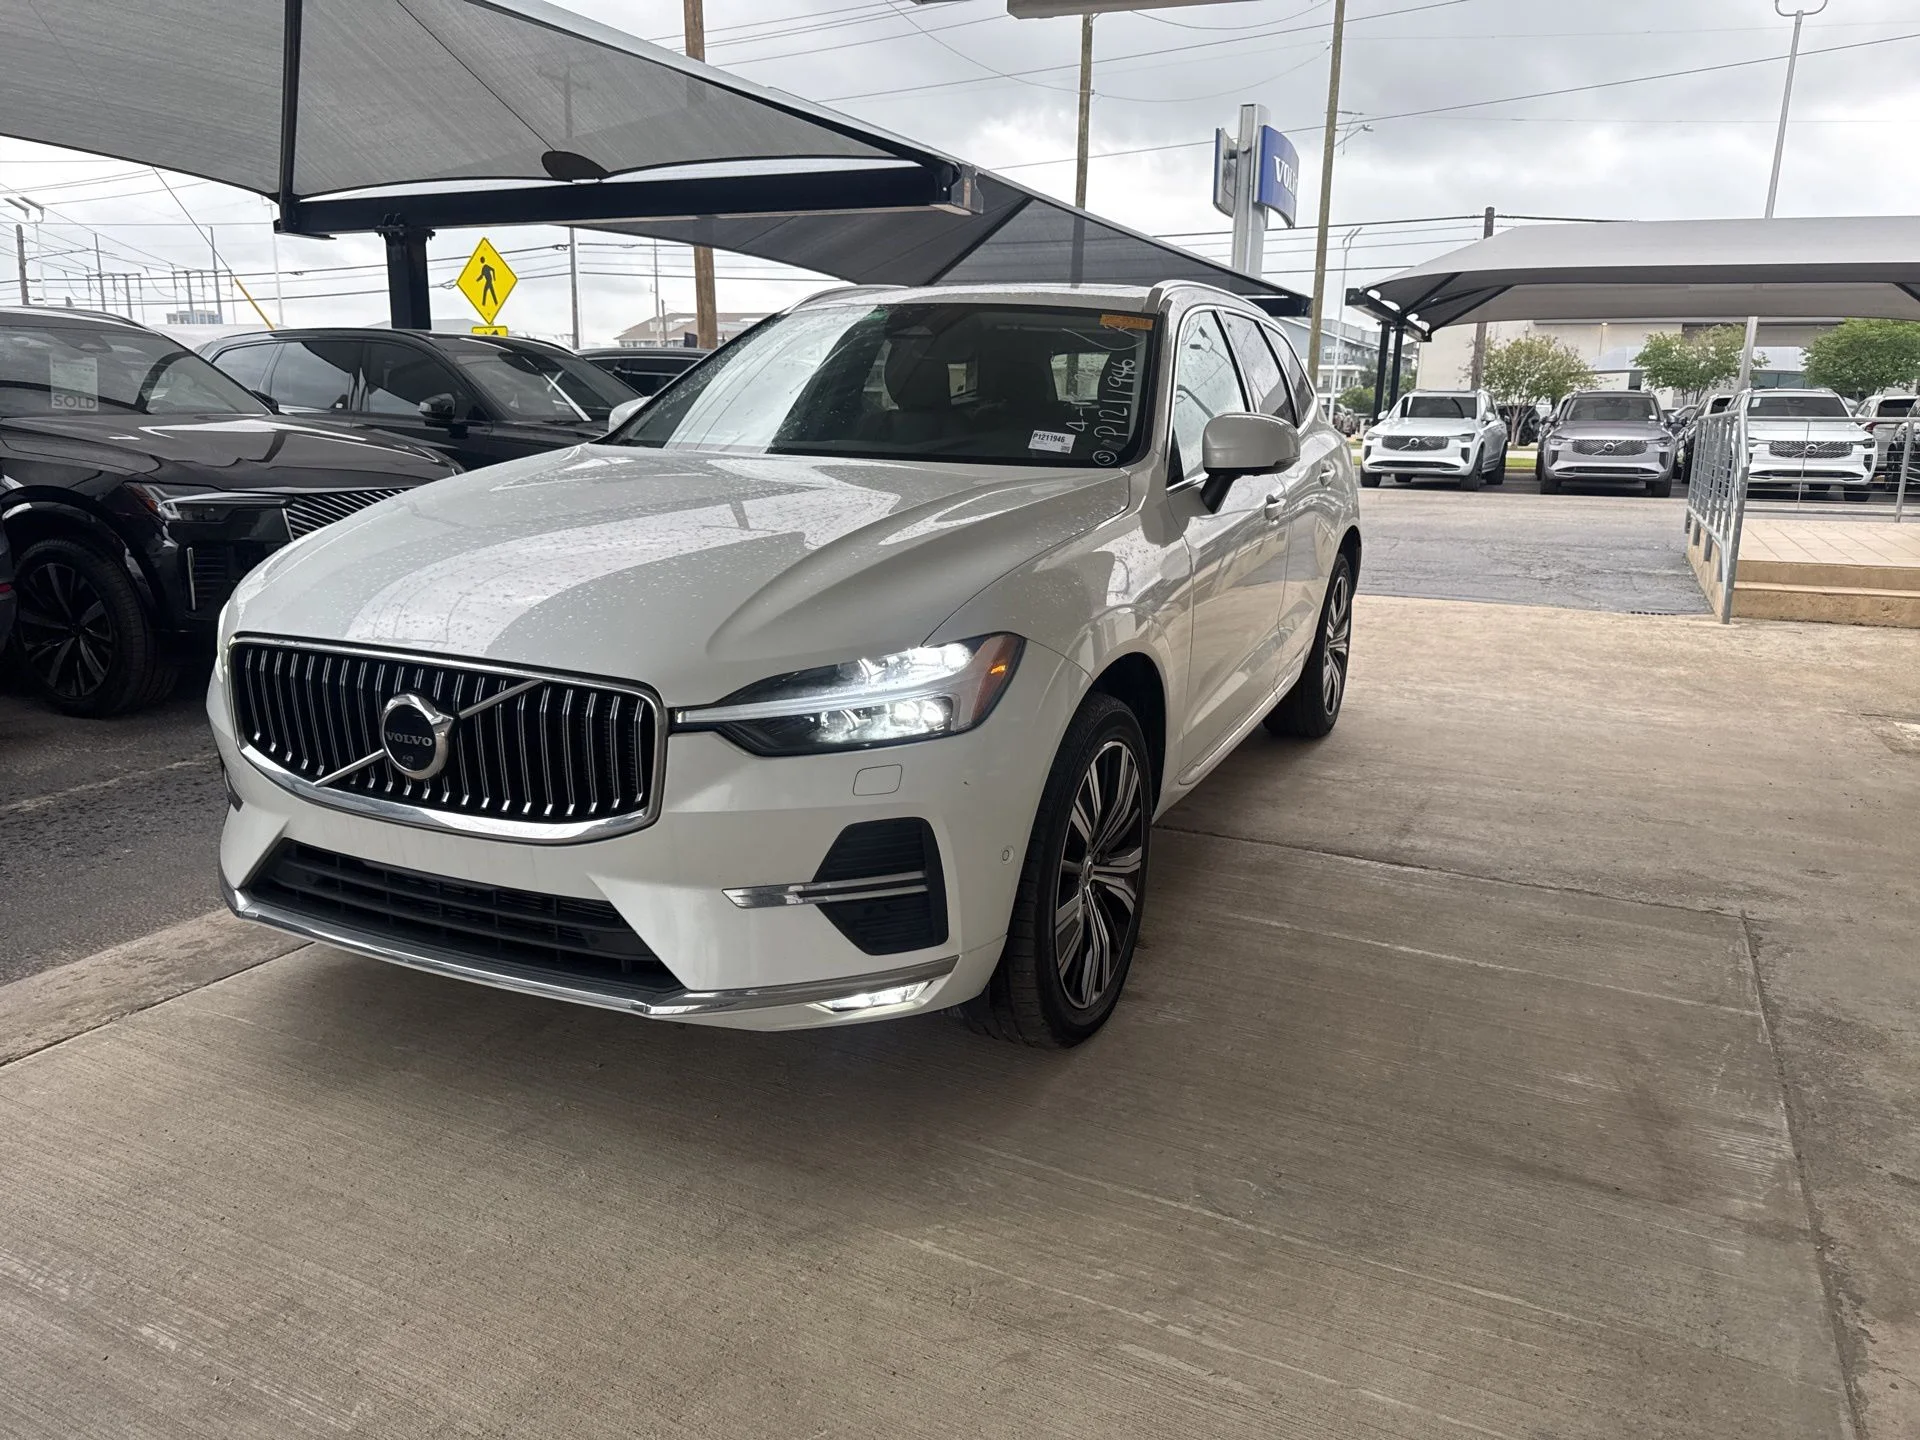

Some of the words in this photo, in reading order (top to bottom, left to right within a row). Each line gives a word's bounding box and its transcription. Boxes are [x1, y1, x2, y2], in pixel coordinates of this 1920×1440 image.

[53, 395, 96, 408] SOLD
[1032, 433, 1066, 443] P1211946
[386, 732, 433, 747] VOLVO
